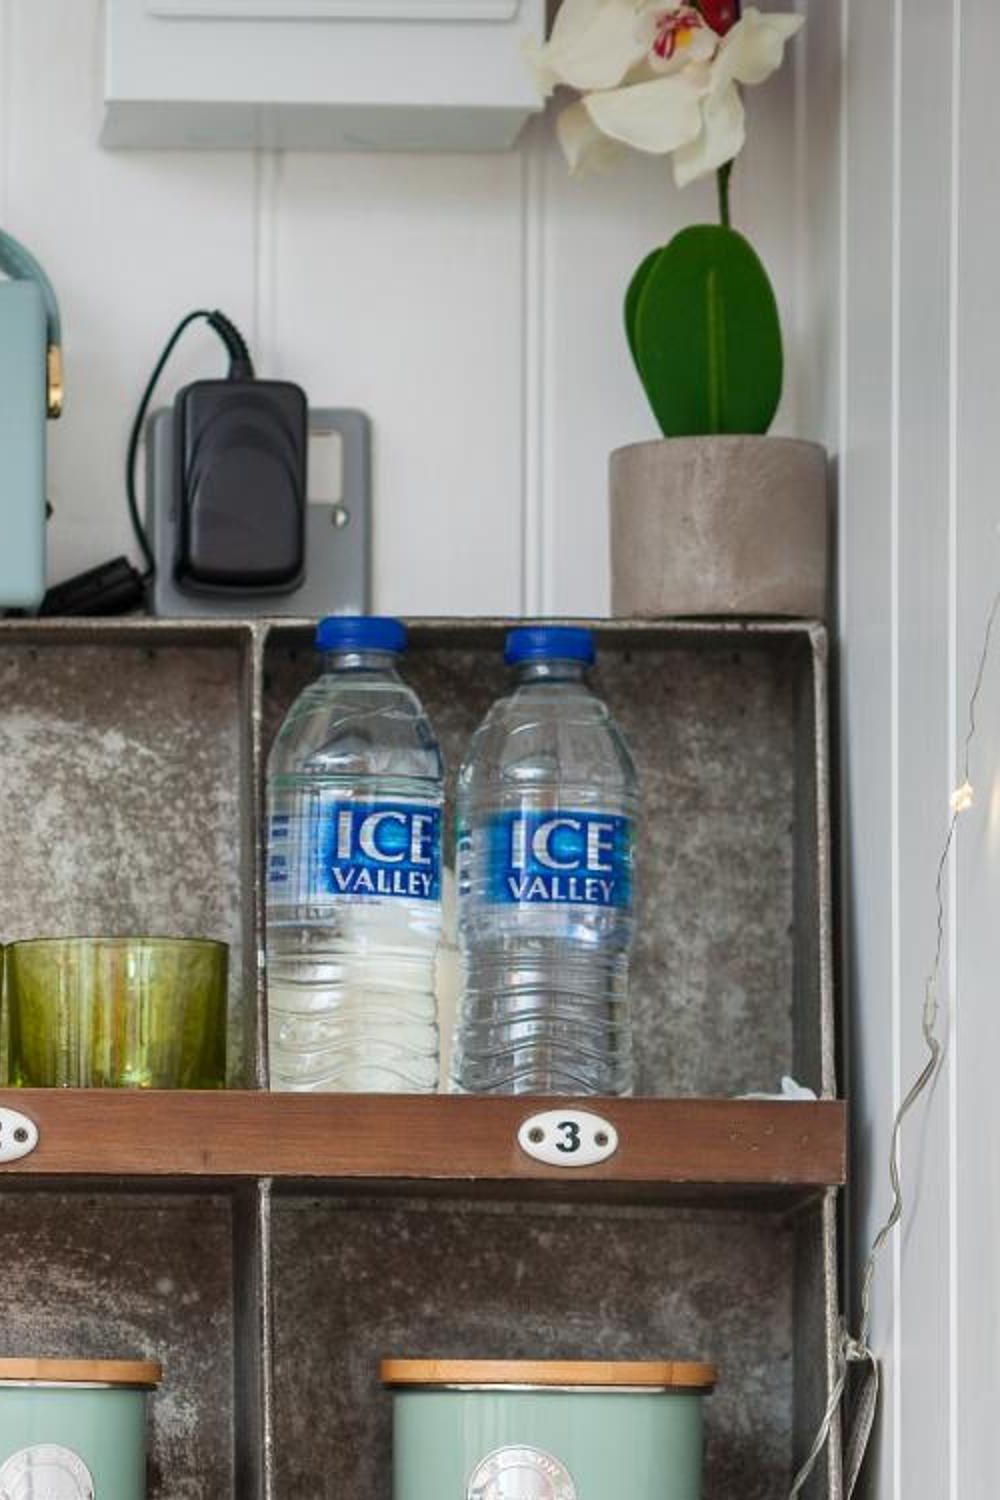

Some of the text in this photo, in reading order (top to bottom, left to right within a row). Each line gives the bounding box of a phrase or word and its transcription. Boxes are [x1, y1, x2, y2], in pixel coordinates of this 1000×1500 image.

[336, 811, 433, 865] ICE
[511, 818, 613, 872] ICE
[331, 867, 433, 896] VALLEY
[507, 875, 615, 902] VALLEY
[555, 1122, 580, 1153] 3
